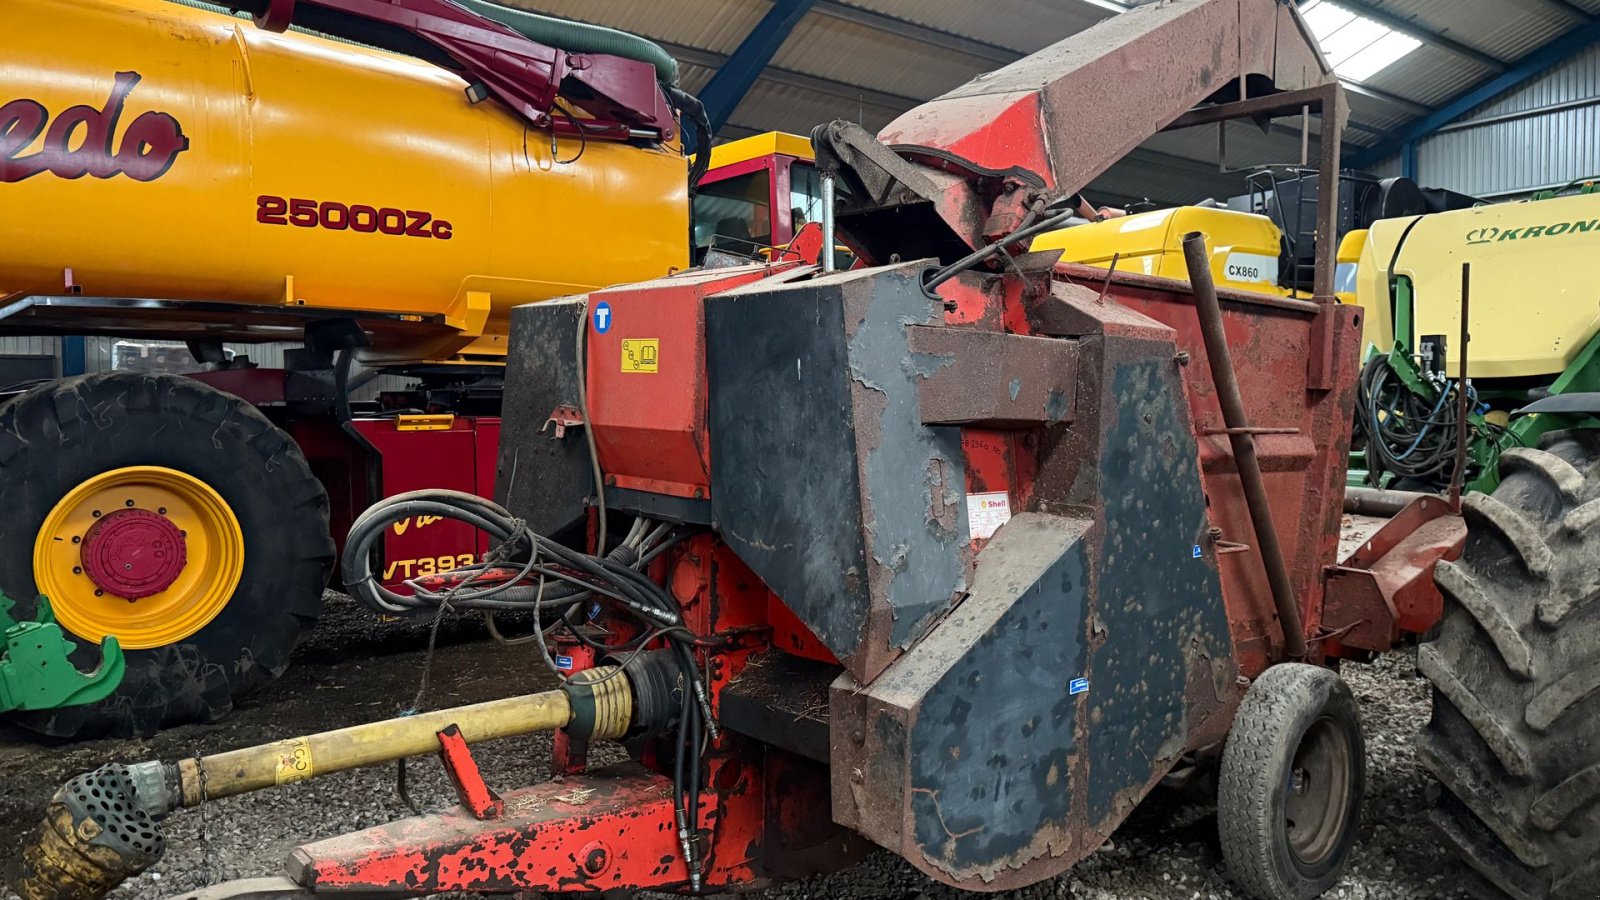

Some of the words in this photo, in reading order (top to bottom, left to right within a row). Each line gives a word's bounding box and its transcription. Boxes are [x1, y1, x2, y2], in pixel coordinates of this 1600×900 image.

[256, 195, 453, 240] 25000Zc
[1497, 219, 1600, 242] KRON
[1228, 264, 1259, 279] CX860
[596, 308, 609, 329] T
[988, 500, 1006, 508] Shell
